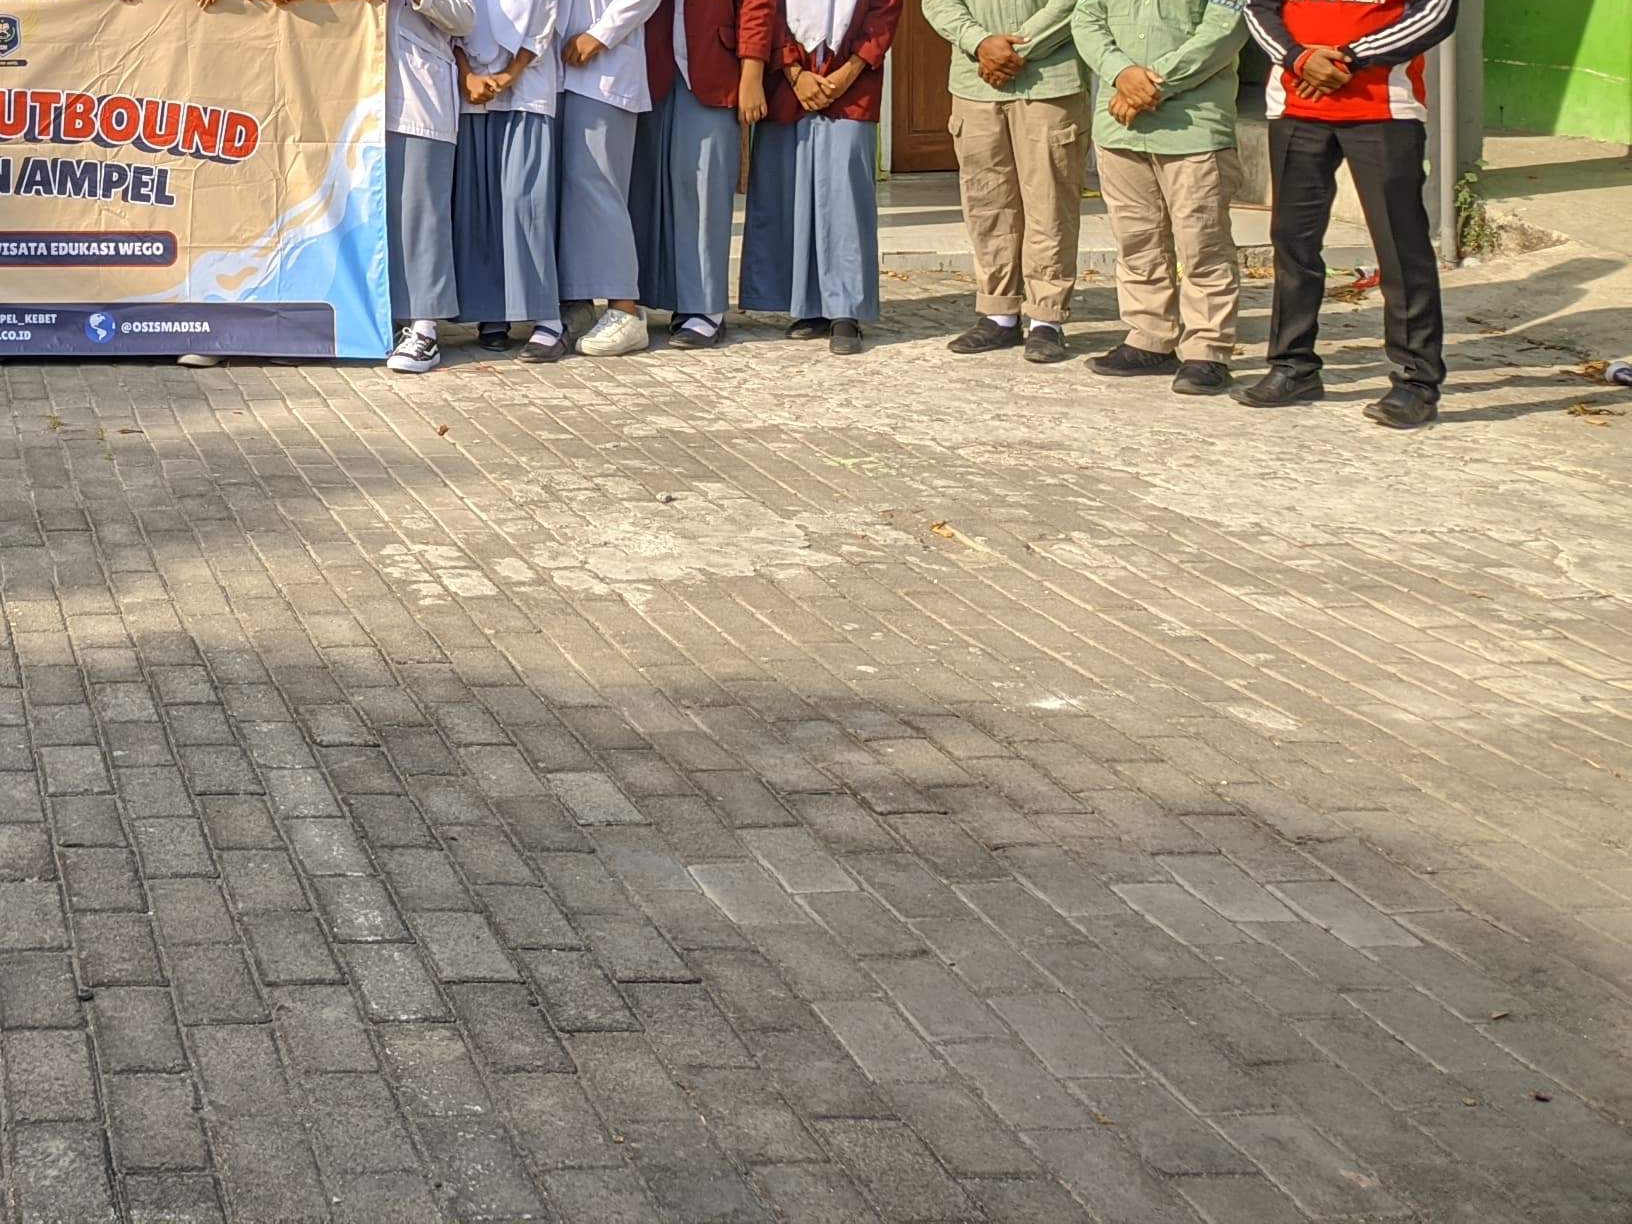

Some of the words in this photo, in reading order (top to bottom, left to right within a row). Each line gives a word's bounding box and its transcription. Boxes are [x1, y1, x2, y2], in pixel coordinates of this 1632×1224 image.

[15, 155, 177, 208] AMPEL
[50, 242, 117, 256] EDUKASI
[118, 241, 164, 256] WEGO
[120, 321, 211, 334] @OSISMADISA
